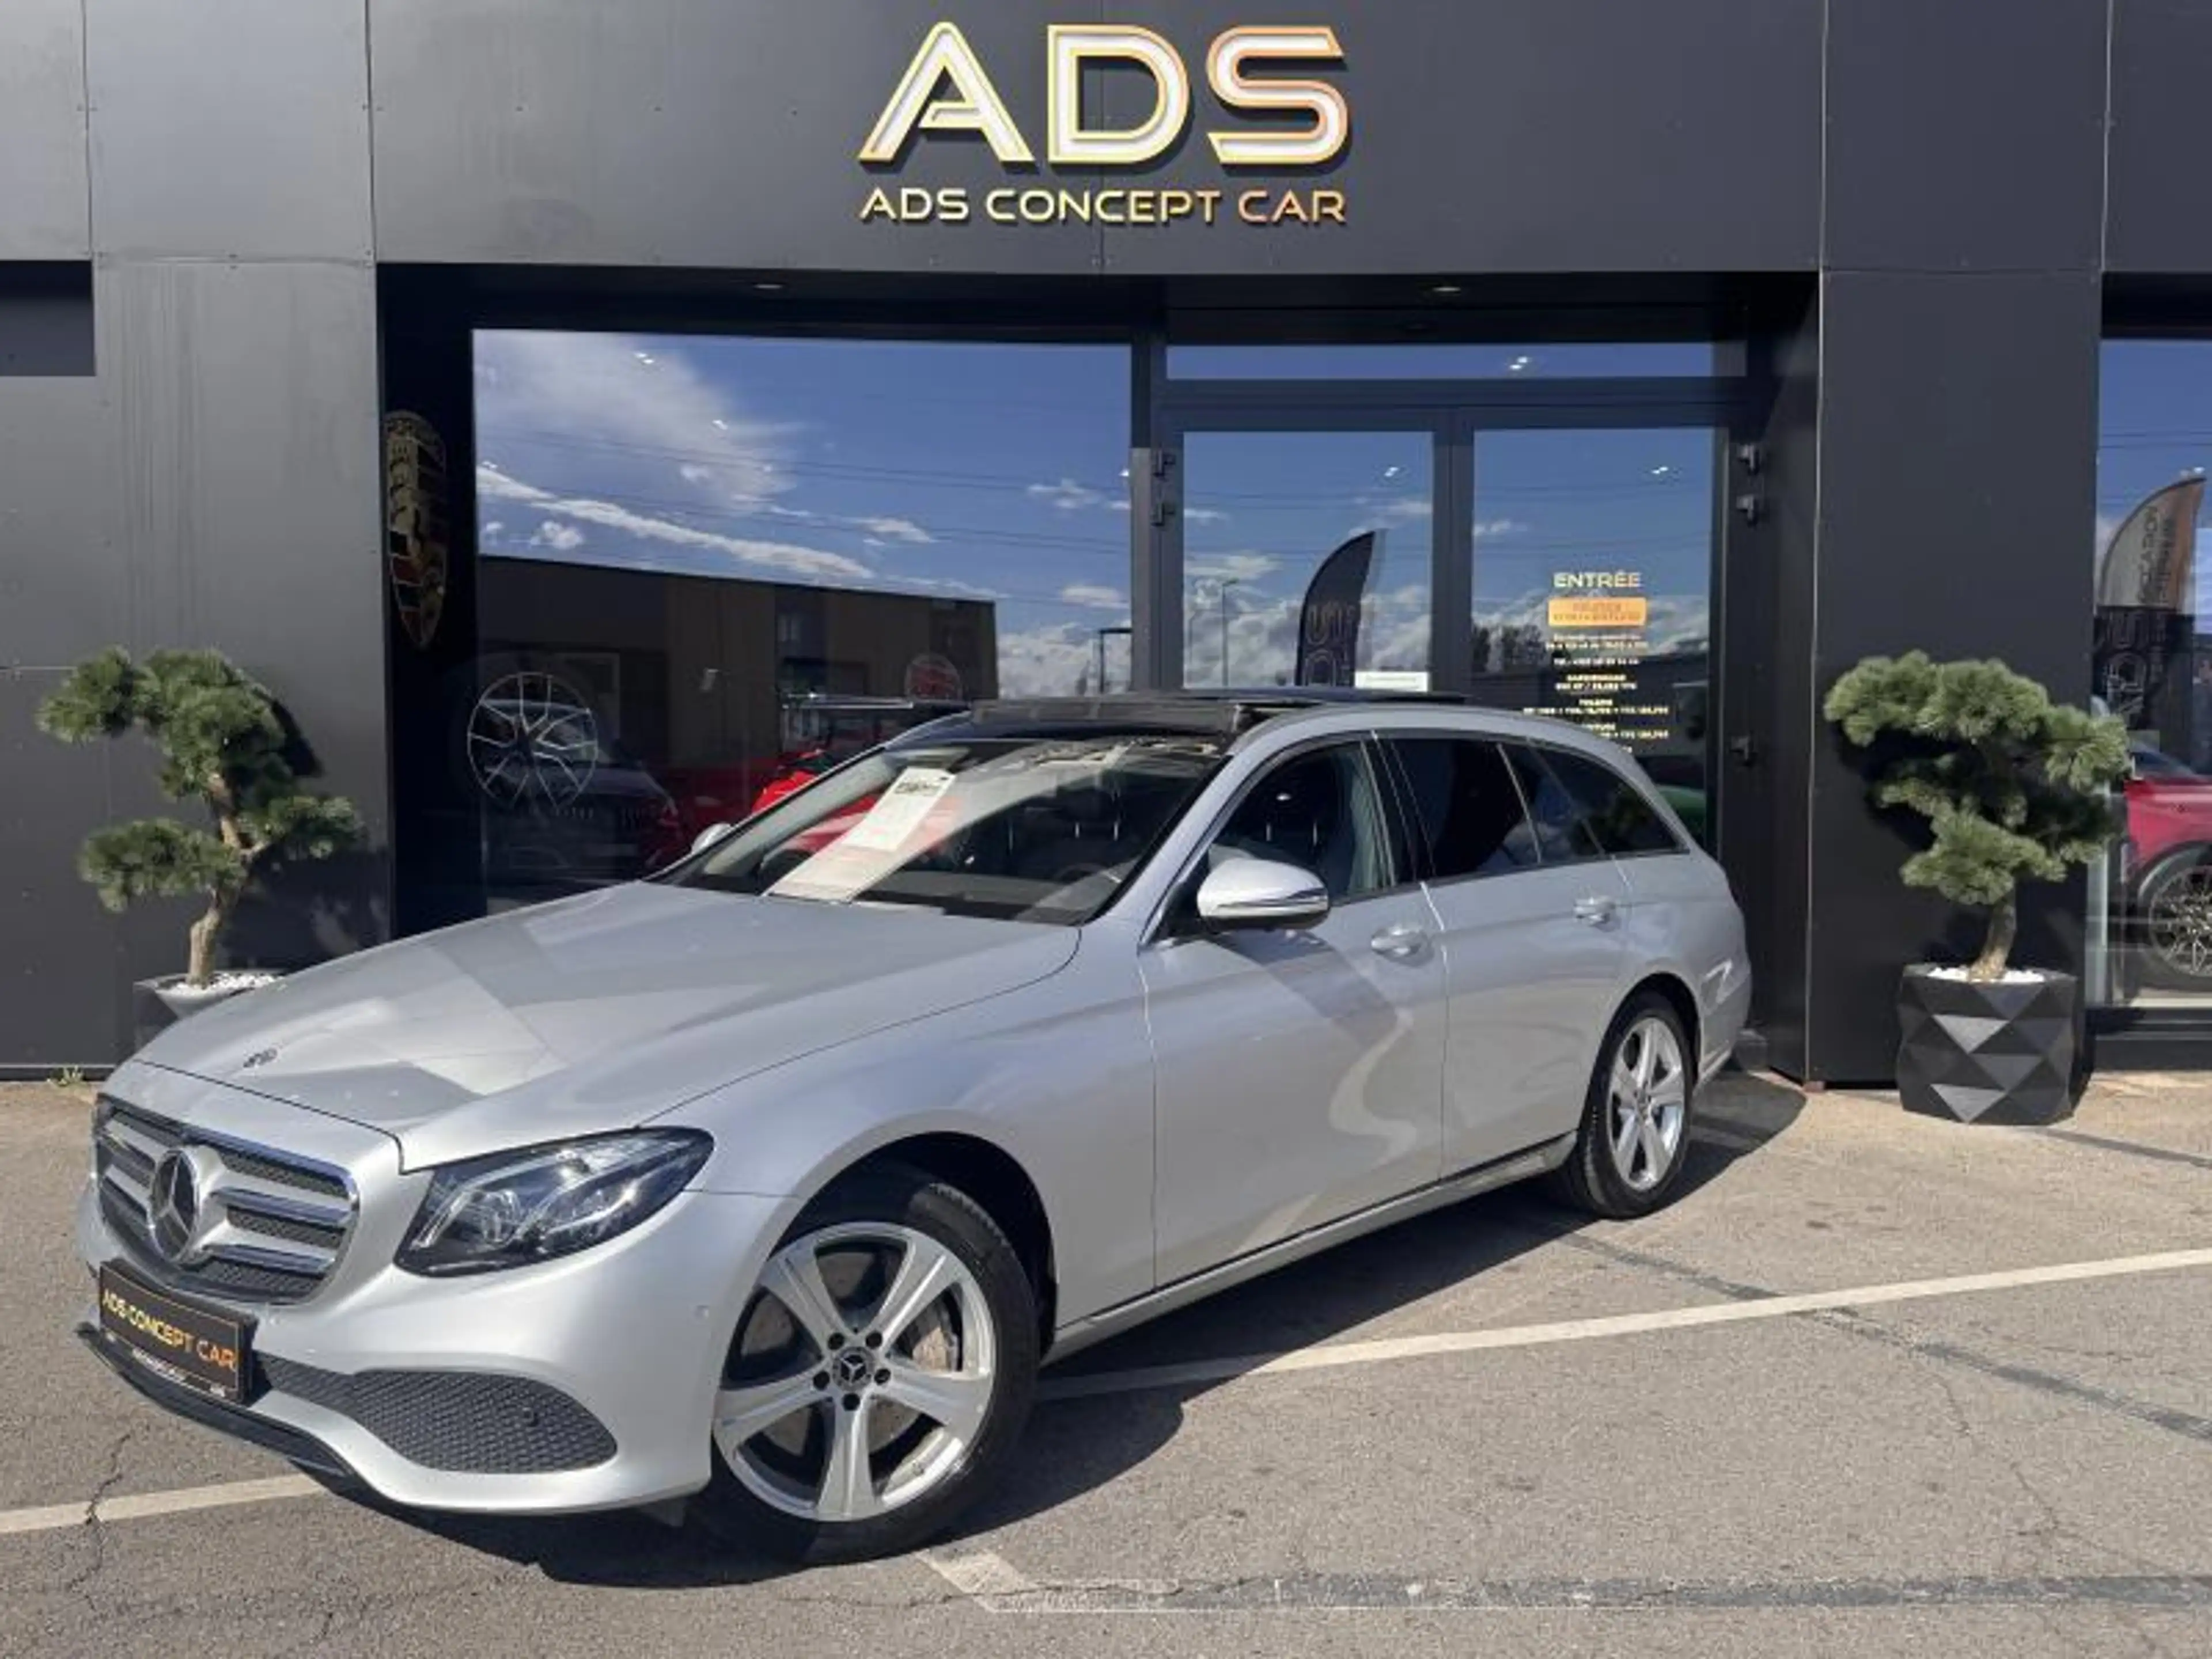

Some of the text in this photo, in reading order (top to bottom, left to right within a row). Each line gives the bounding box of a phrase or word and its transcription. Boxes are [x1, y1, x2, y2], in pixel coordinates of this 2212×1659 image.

[857, 21, 1349, 165] ADS
[859, 188, 1347, 224] ADS CONCEPT CAR
[1554, 569, 1642, 588] ENTRÉE
[196, 1339, 237, 1372] CAR
